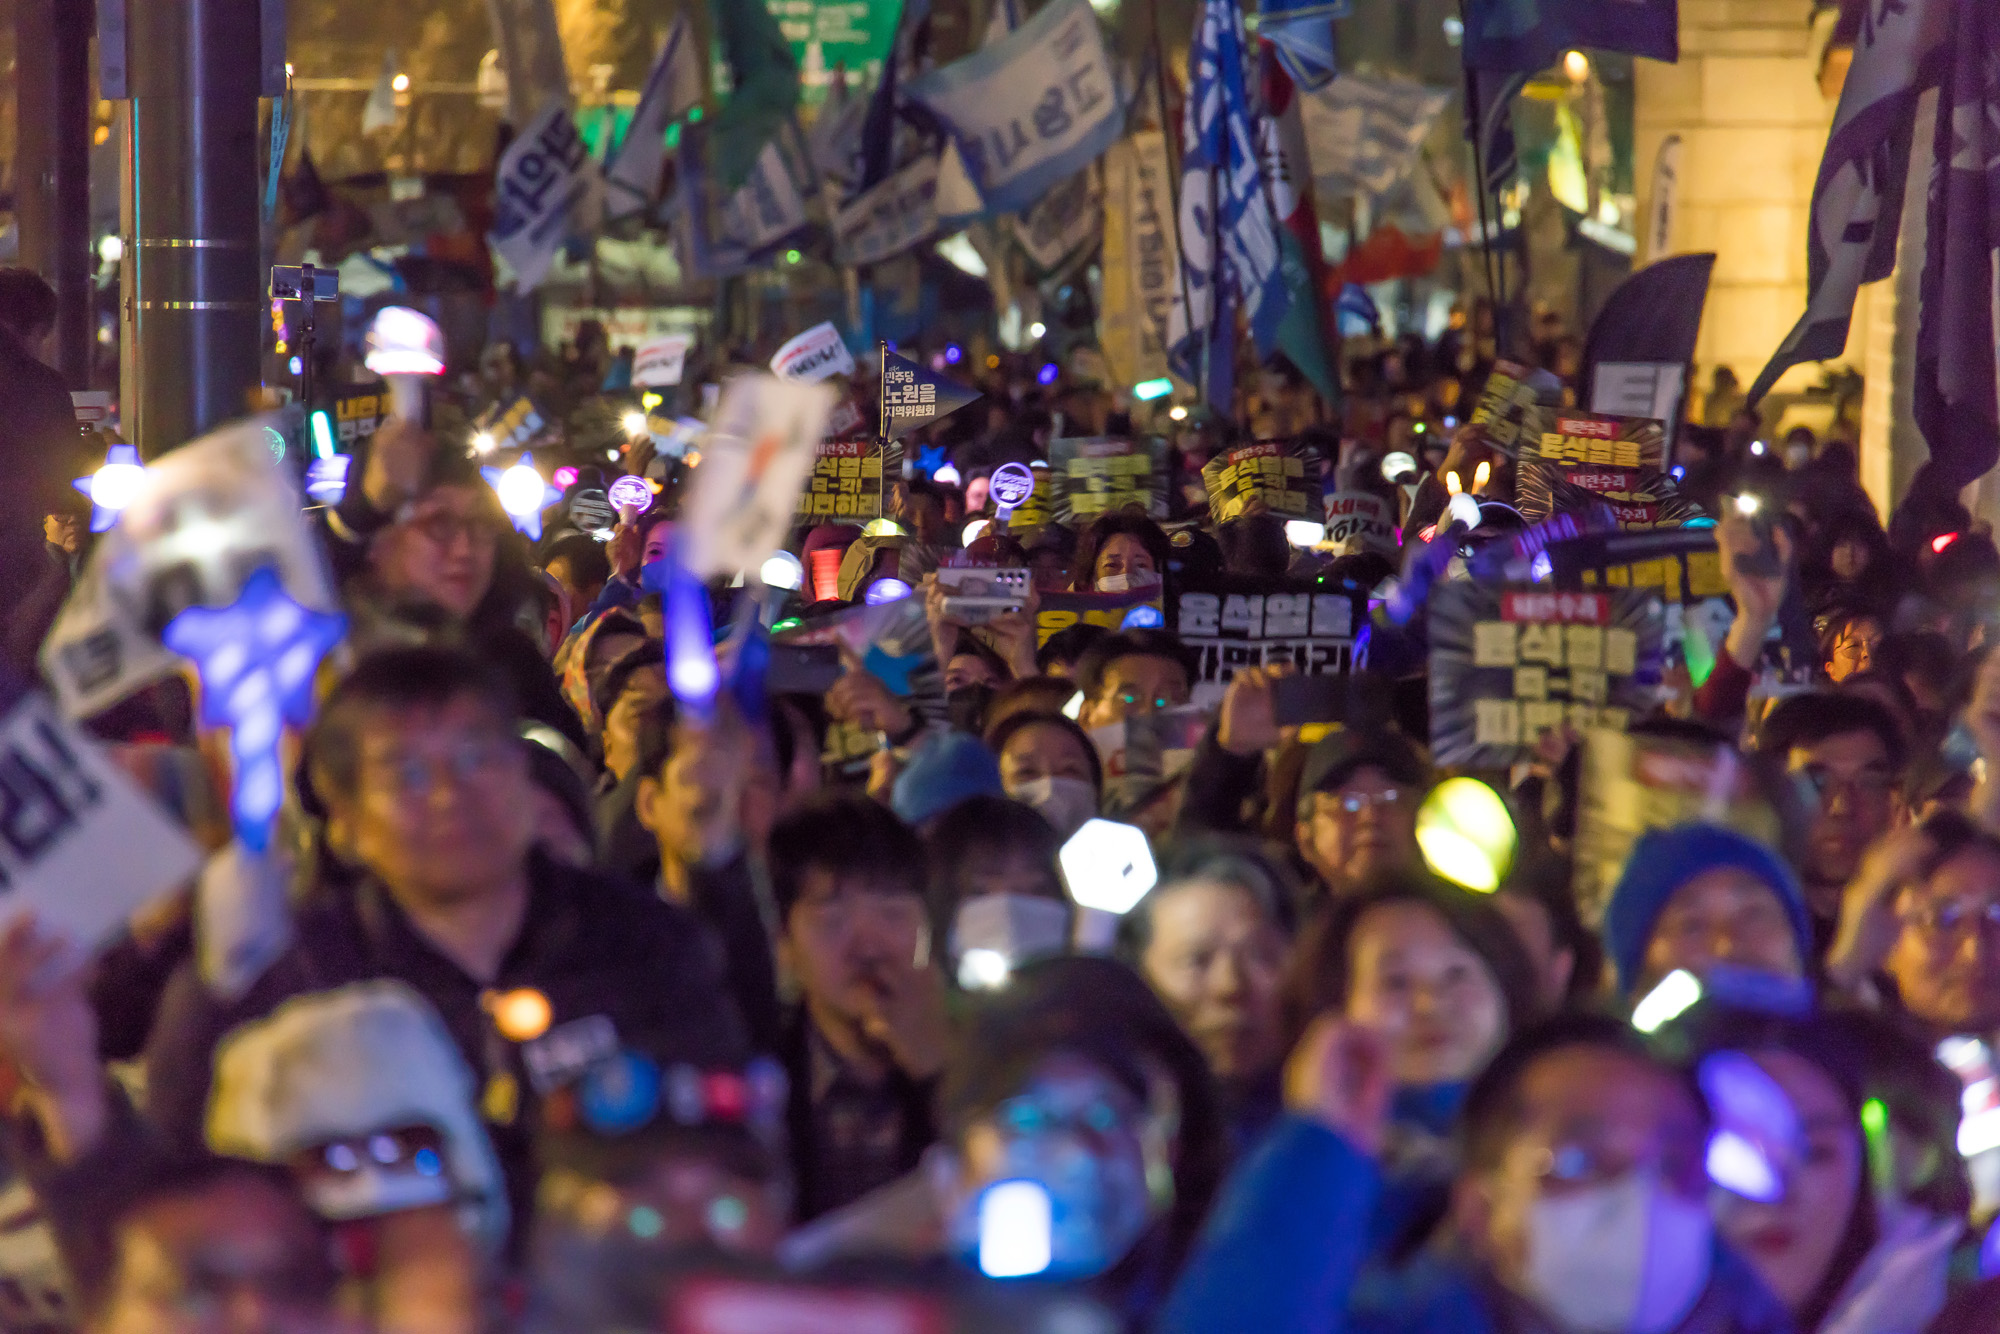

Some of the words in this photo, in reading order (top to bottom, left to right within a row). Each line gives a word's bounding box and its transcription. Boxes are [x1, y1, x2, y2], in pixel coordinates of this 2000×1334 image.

[885, 371, 914, 384] 민주당
[885, 384, 936, 404] 노원을
[885, 405, 936, 417] 지역위원회
[1540, 433, 1641, 467] 윤석열을
[806, 457, 881, 478] 석열을
[1179, 593, 1352, 639] 윤석열을
